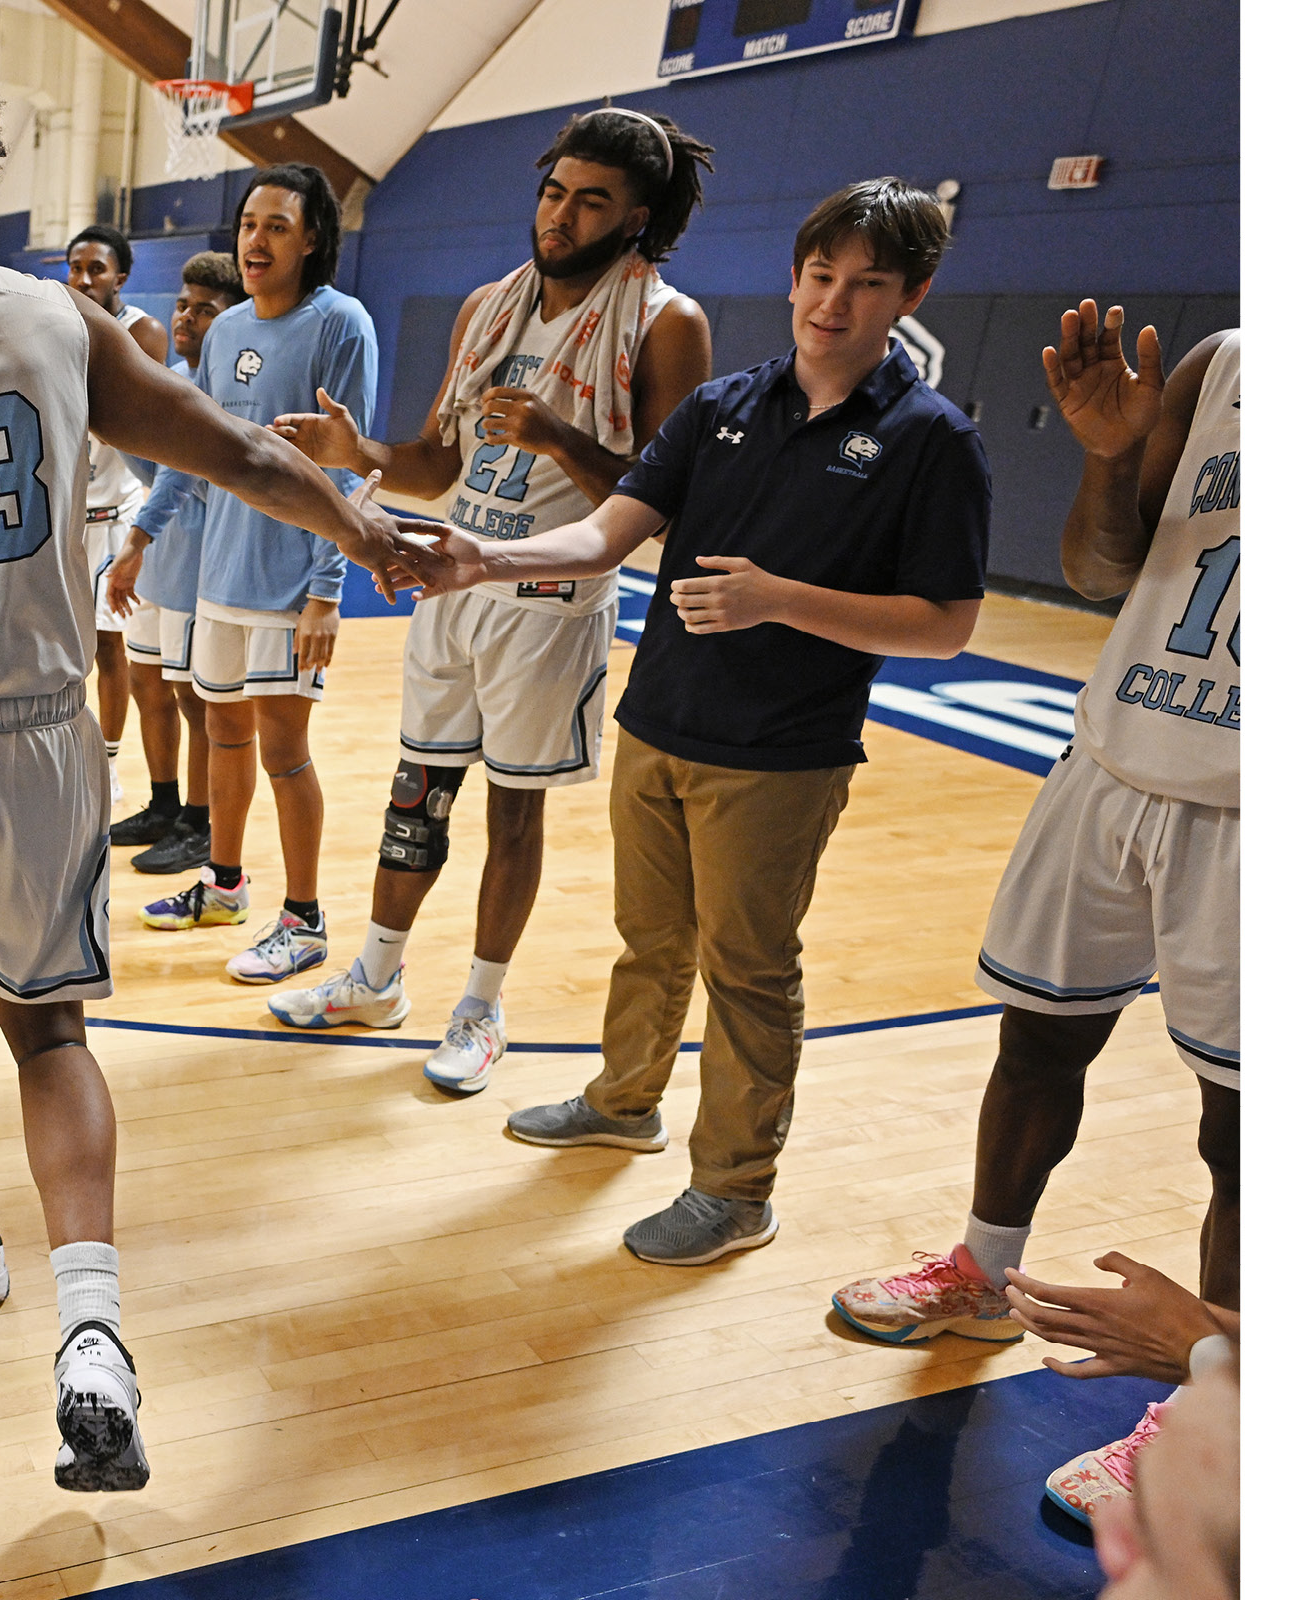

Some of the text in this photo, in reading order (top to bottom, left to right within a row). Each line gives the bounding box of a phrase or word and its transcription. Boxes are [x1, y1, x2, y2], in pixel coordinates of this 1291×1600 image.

[845, 10, 893, 39] SCORE
[742, 33, 788, 59] MATCH
[660, 53, 695, 76] SCORE
[465, 415, 537, 503] 21
